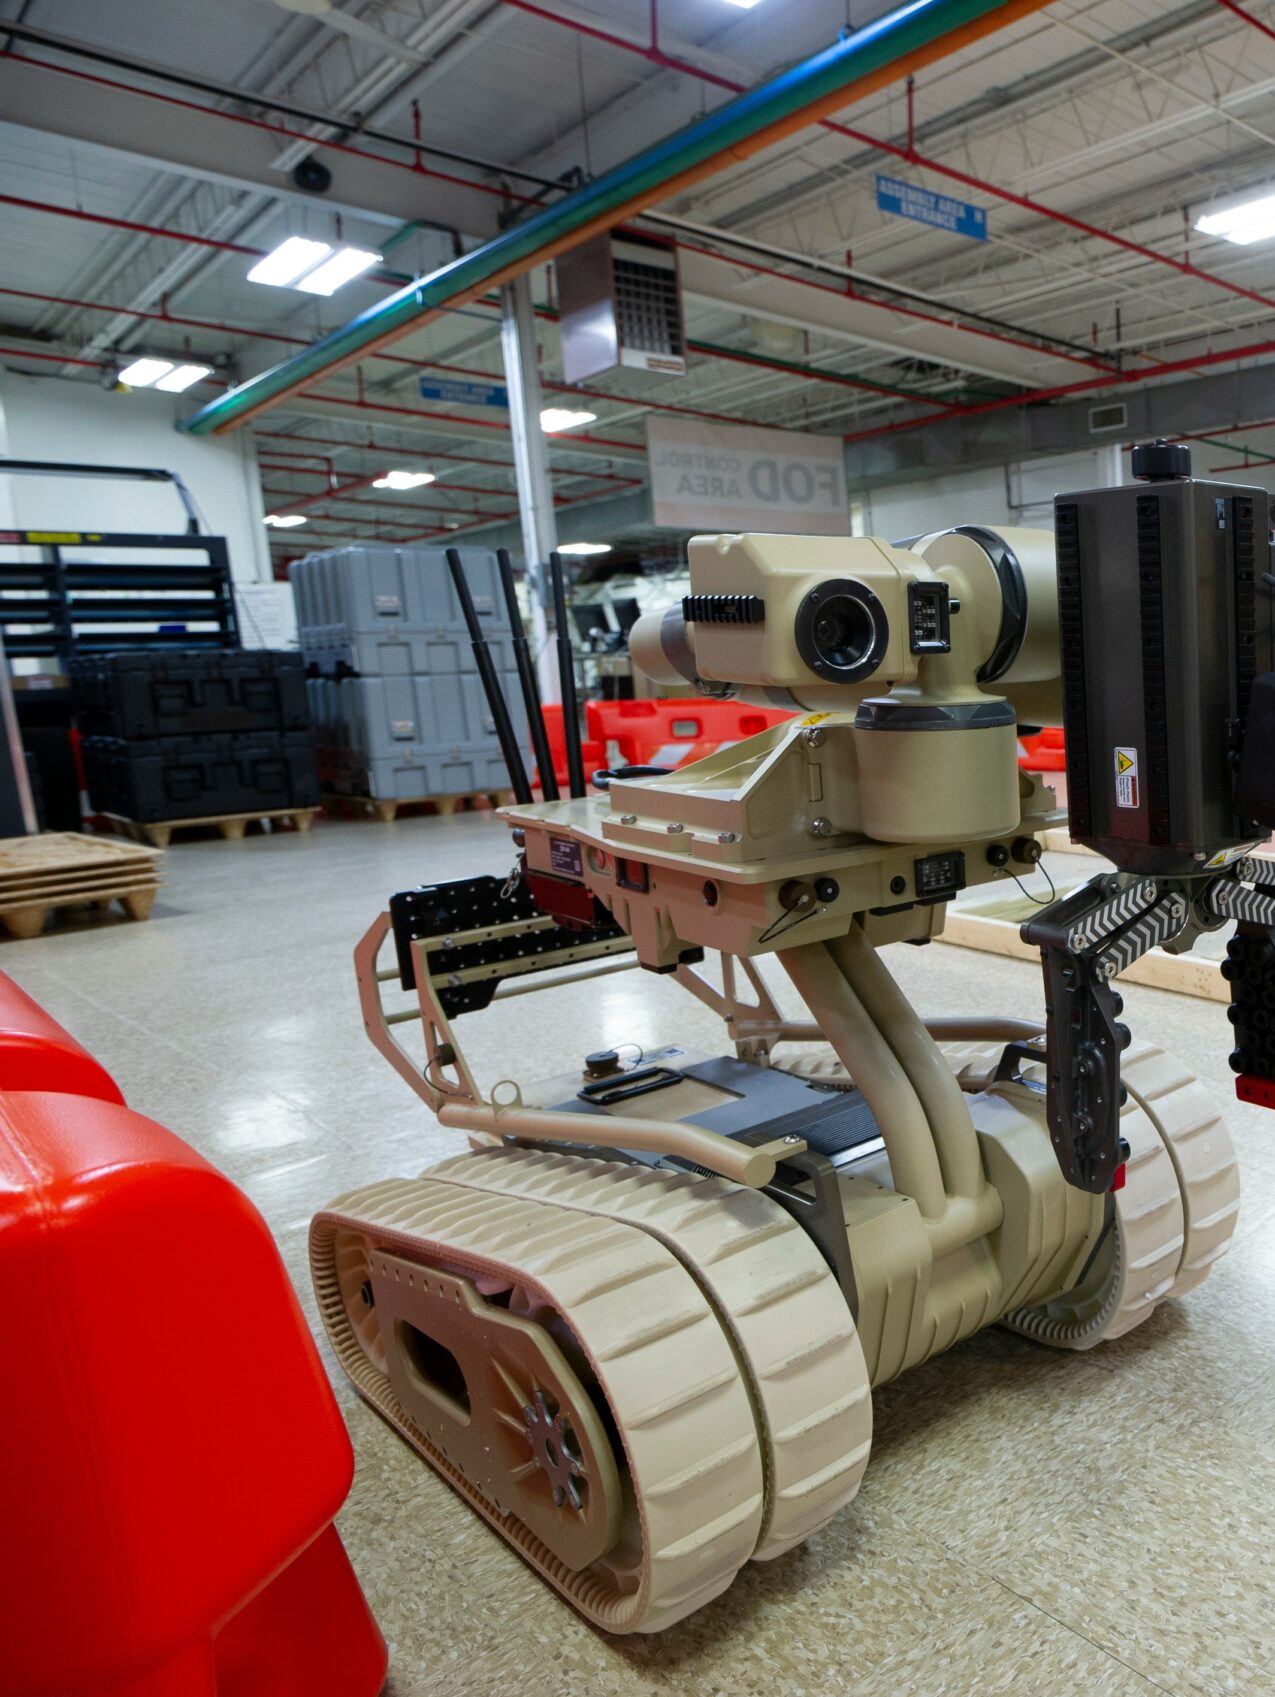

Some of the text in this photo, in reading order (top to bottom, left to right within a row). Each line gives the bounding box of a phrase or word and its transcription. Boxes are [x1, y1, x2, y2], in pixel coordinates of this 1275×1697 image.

[880, 178, 937, 211] ASSEMBLY
[939, 197, 967, 219] AREA
[901, 200, 958, 231] ENTRANCE
